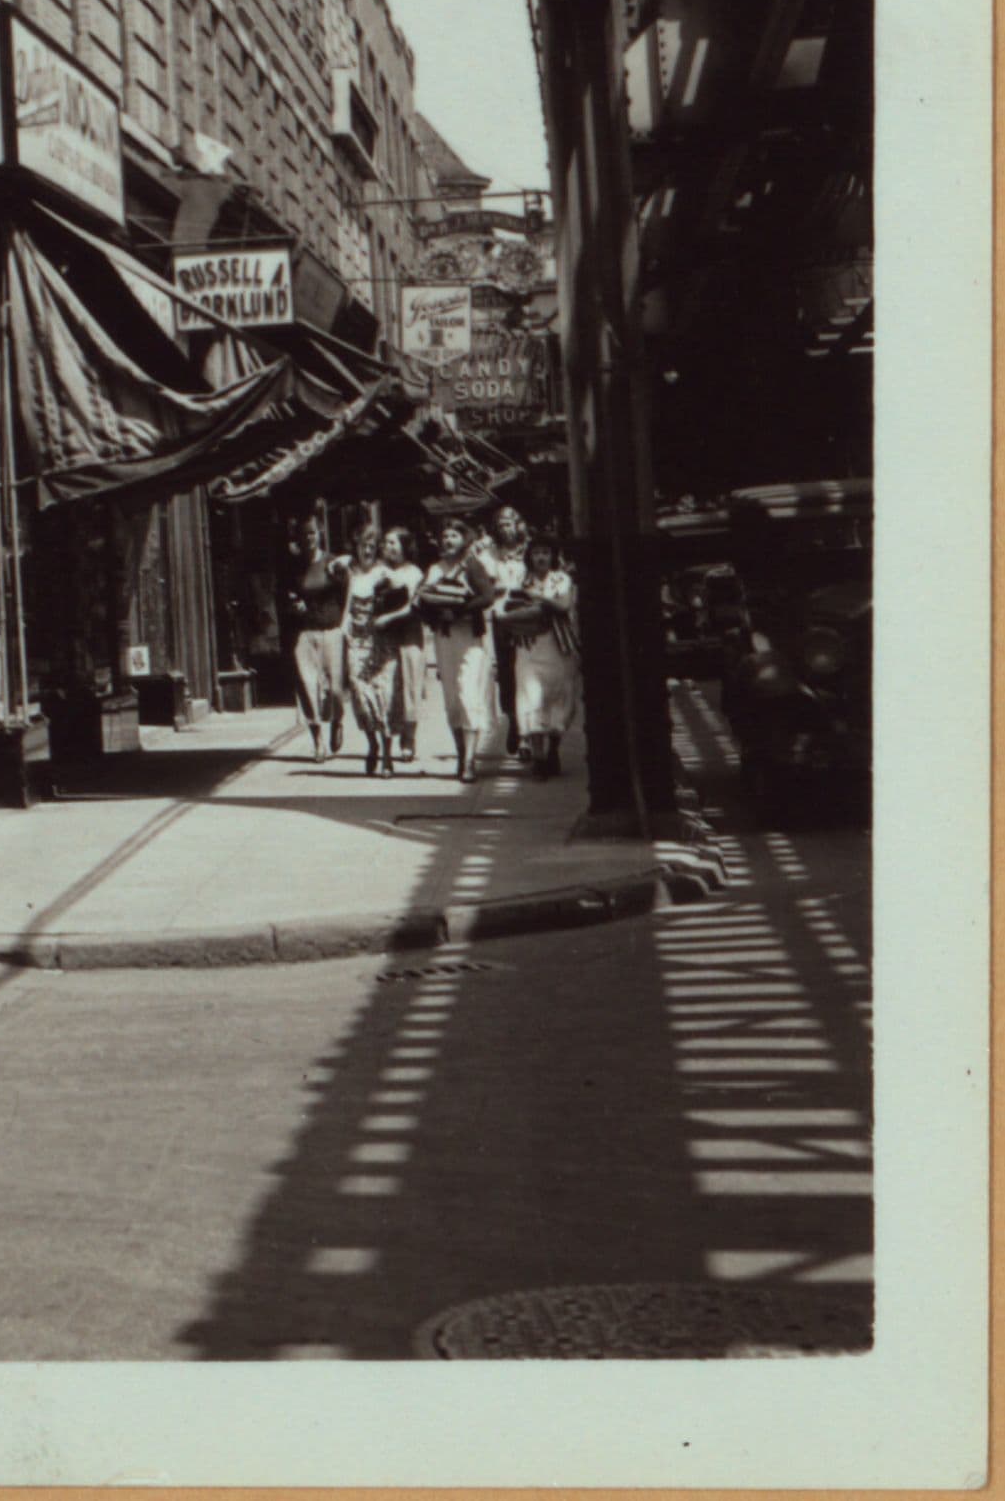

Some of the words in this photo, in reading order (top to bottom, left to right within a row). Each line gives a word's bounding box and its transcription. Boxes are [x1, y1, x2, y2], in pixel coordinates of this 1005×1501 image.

[178, 257, 263, 294] RUSSELL
[180, 289, 288, 324] BORKLUND
[440, 357, 530, 380] CANDY
[454, 379, 515, 400] SODA
